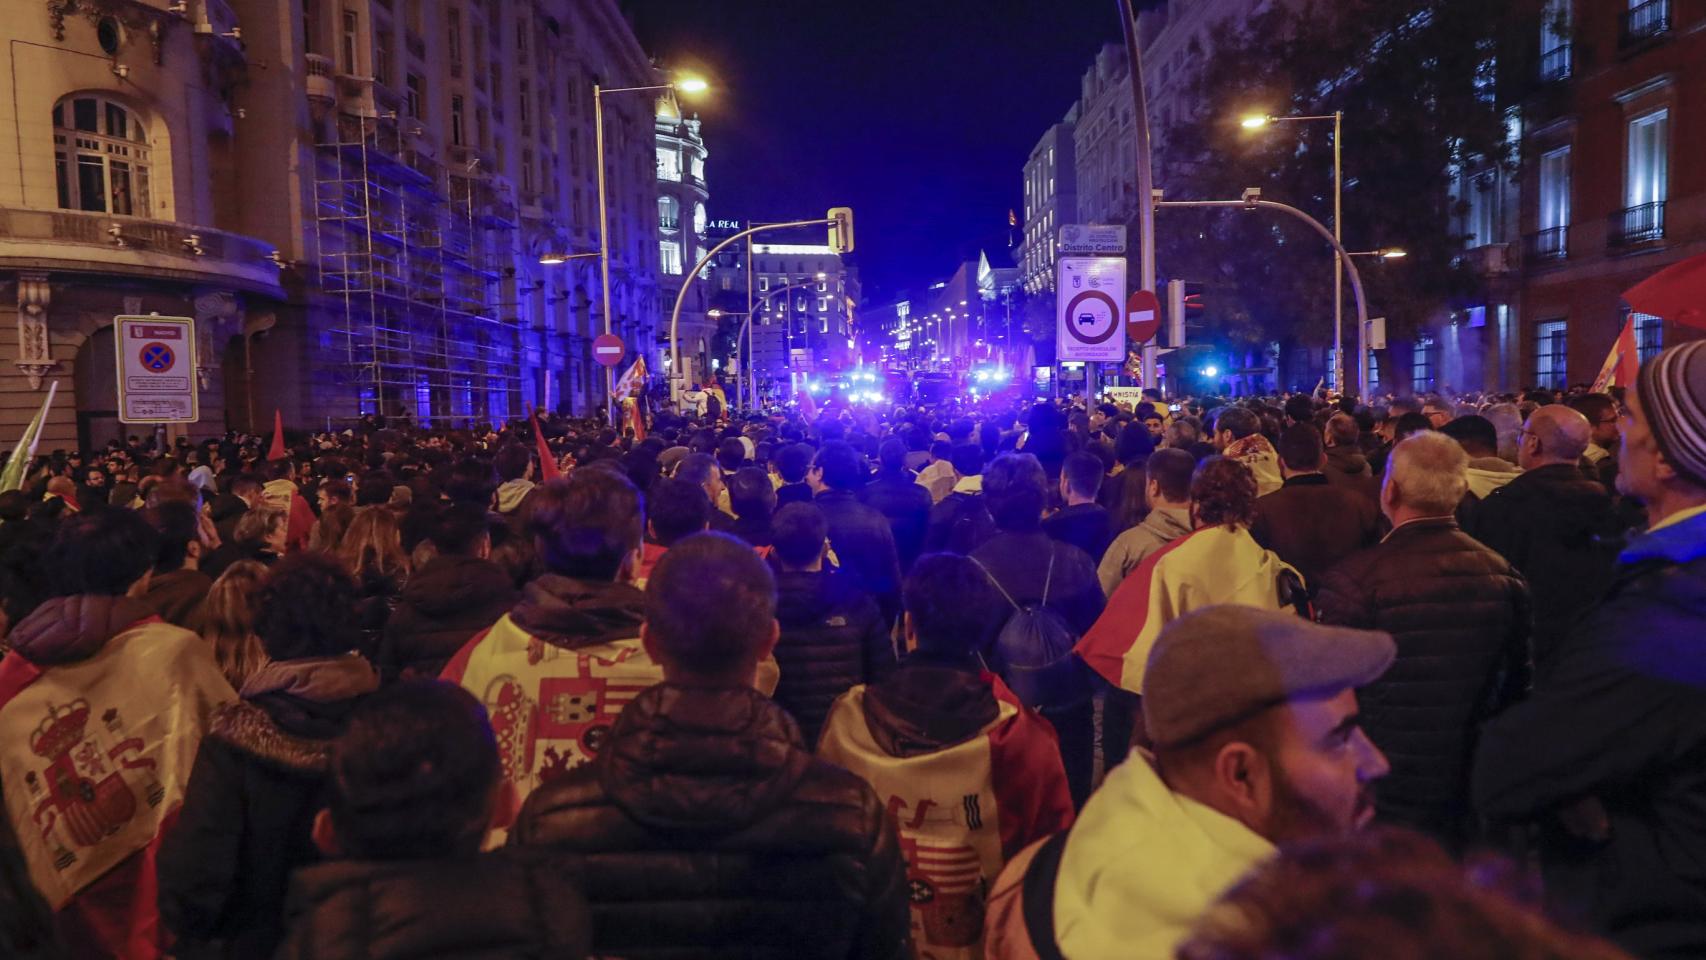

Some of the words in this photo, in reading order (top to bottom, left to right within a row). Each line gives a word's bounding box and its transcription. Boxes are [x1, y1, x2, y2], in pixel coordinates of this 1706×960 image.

[718, 220, 740, 229] REAL
[1063, 243, 1094, 251] Distrito
[1095, 243, 1124, 251] Centro
